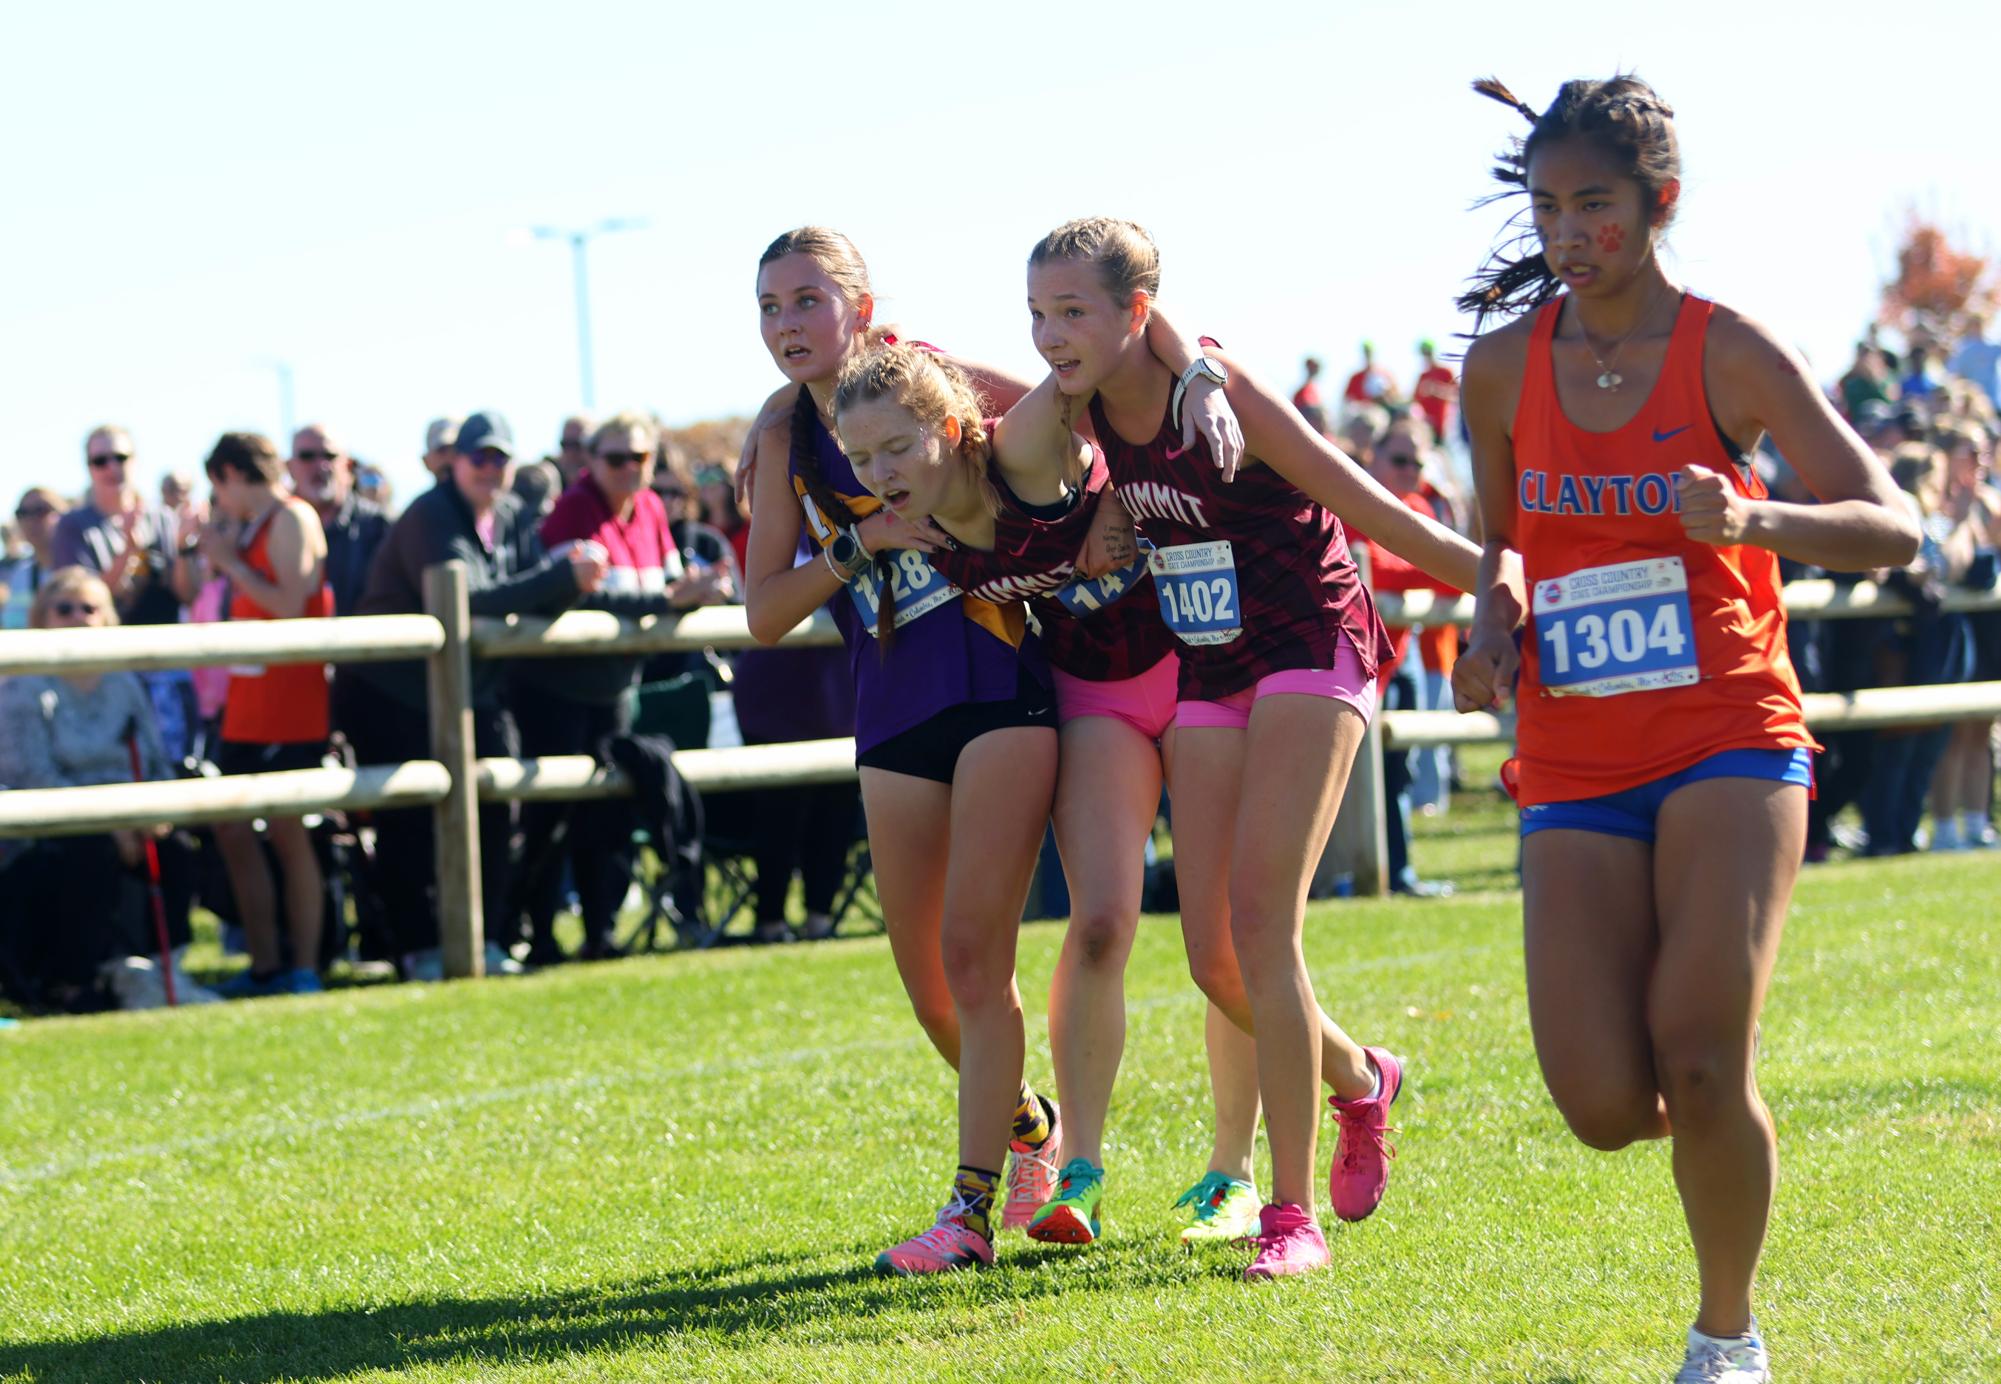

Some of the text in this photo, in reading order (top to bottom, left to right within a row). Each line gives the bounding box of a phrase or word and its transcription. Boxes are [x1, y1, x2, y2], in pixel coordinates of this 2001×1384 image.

[1116, 481, 1211, 528] UMMIT
[1166, 547, 1213, 562] CROSS COUNTRY
[854, 549, 937, 614] 128
[968, 560, 1074, 605] UMMIT
[1162, 578, 1234, 623] 1402
[1569, 566, 1649, 590] CROSS COUNTRY
[1544, 603, 1686, 673] 1304
